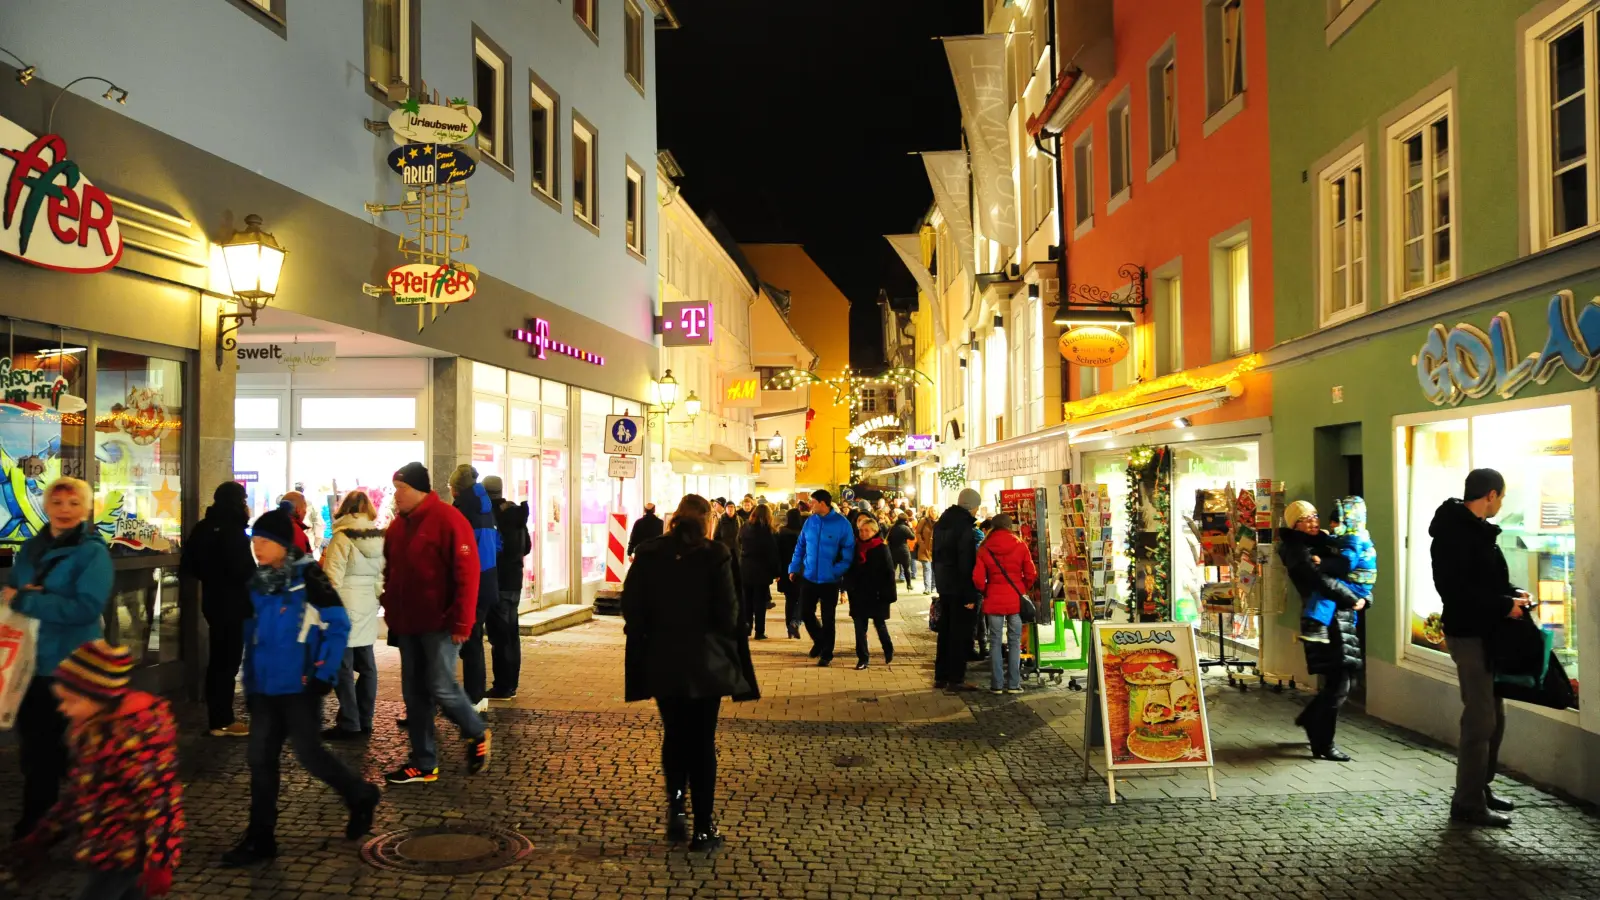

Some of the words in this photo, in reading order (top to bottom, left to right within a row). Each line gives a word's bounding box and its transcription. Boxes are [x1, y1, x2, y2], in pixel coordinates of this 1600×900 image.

[410, 117, 468, 133] Urlaubswelt
[440, 159, 457, 169] and
[403, 164, 435, 184] ARILA
[396, 295, 426, 304] Metzgerei
[680, 307, 706, 338] T
[534, 317, 550, 360] T
[1062, 332, 1126, 349] Buchhandlung
[1076, 355, 1111, 365] Schreiber
[727, 379, 757, 401] H&M
[613, 444, 633, 453] ZONE
[1112, 630, 1176, 645] GOLAN
